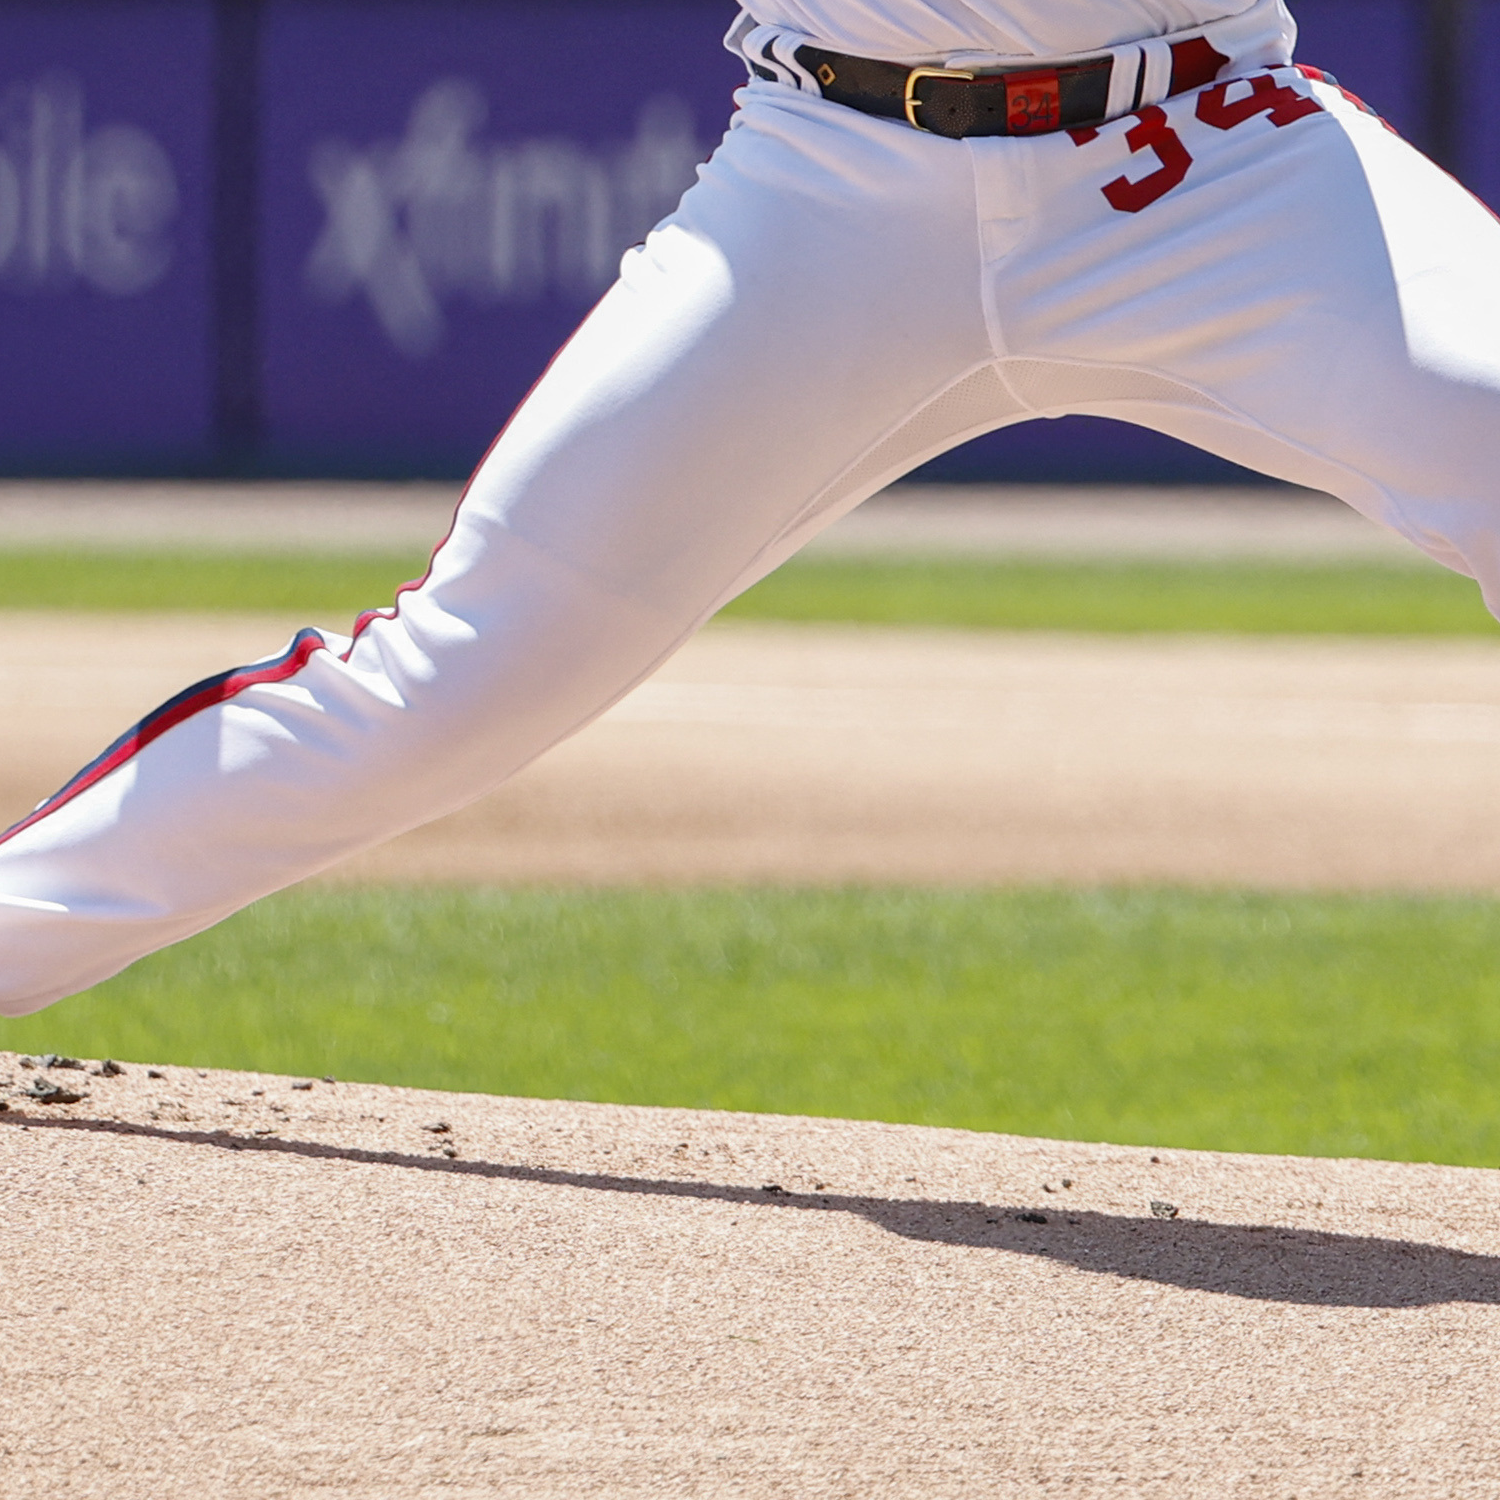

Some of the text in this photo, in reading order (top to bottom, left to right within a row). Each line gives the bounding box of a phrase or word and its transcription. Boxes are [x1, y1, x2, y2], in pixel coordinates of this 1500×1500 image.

[1011, 94, 1055, 131] 34
[1065, 73, 1325, 213] 34
[308, 77, 706, 356] xfinit
